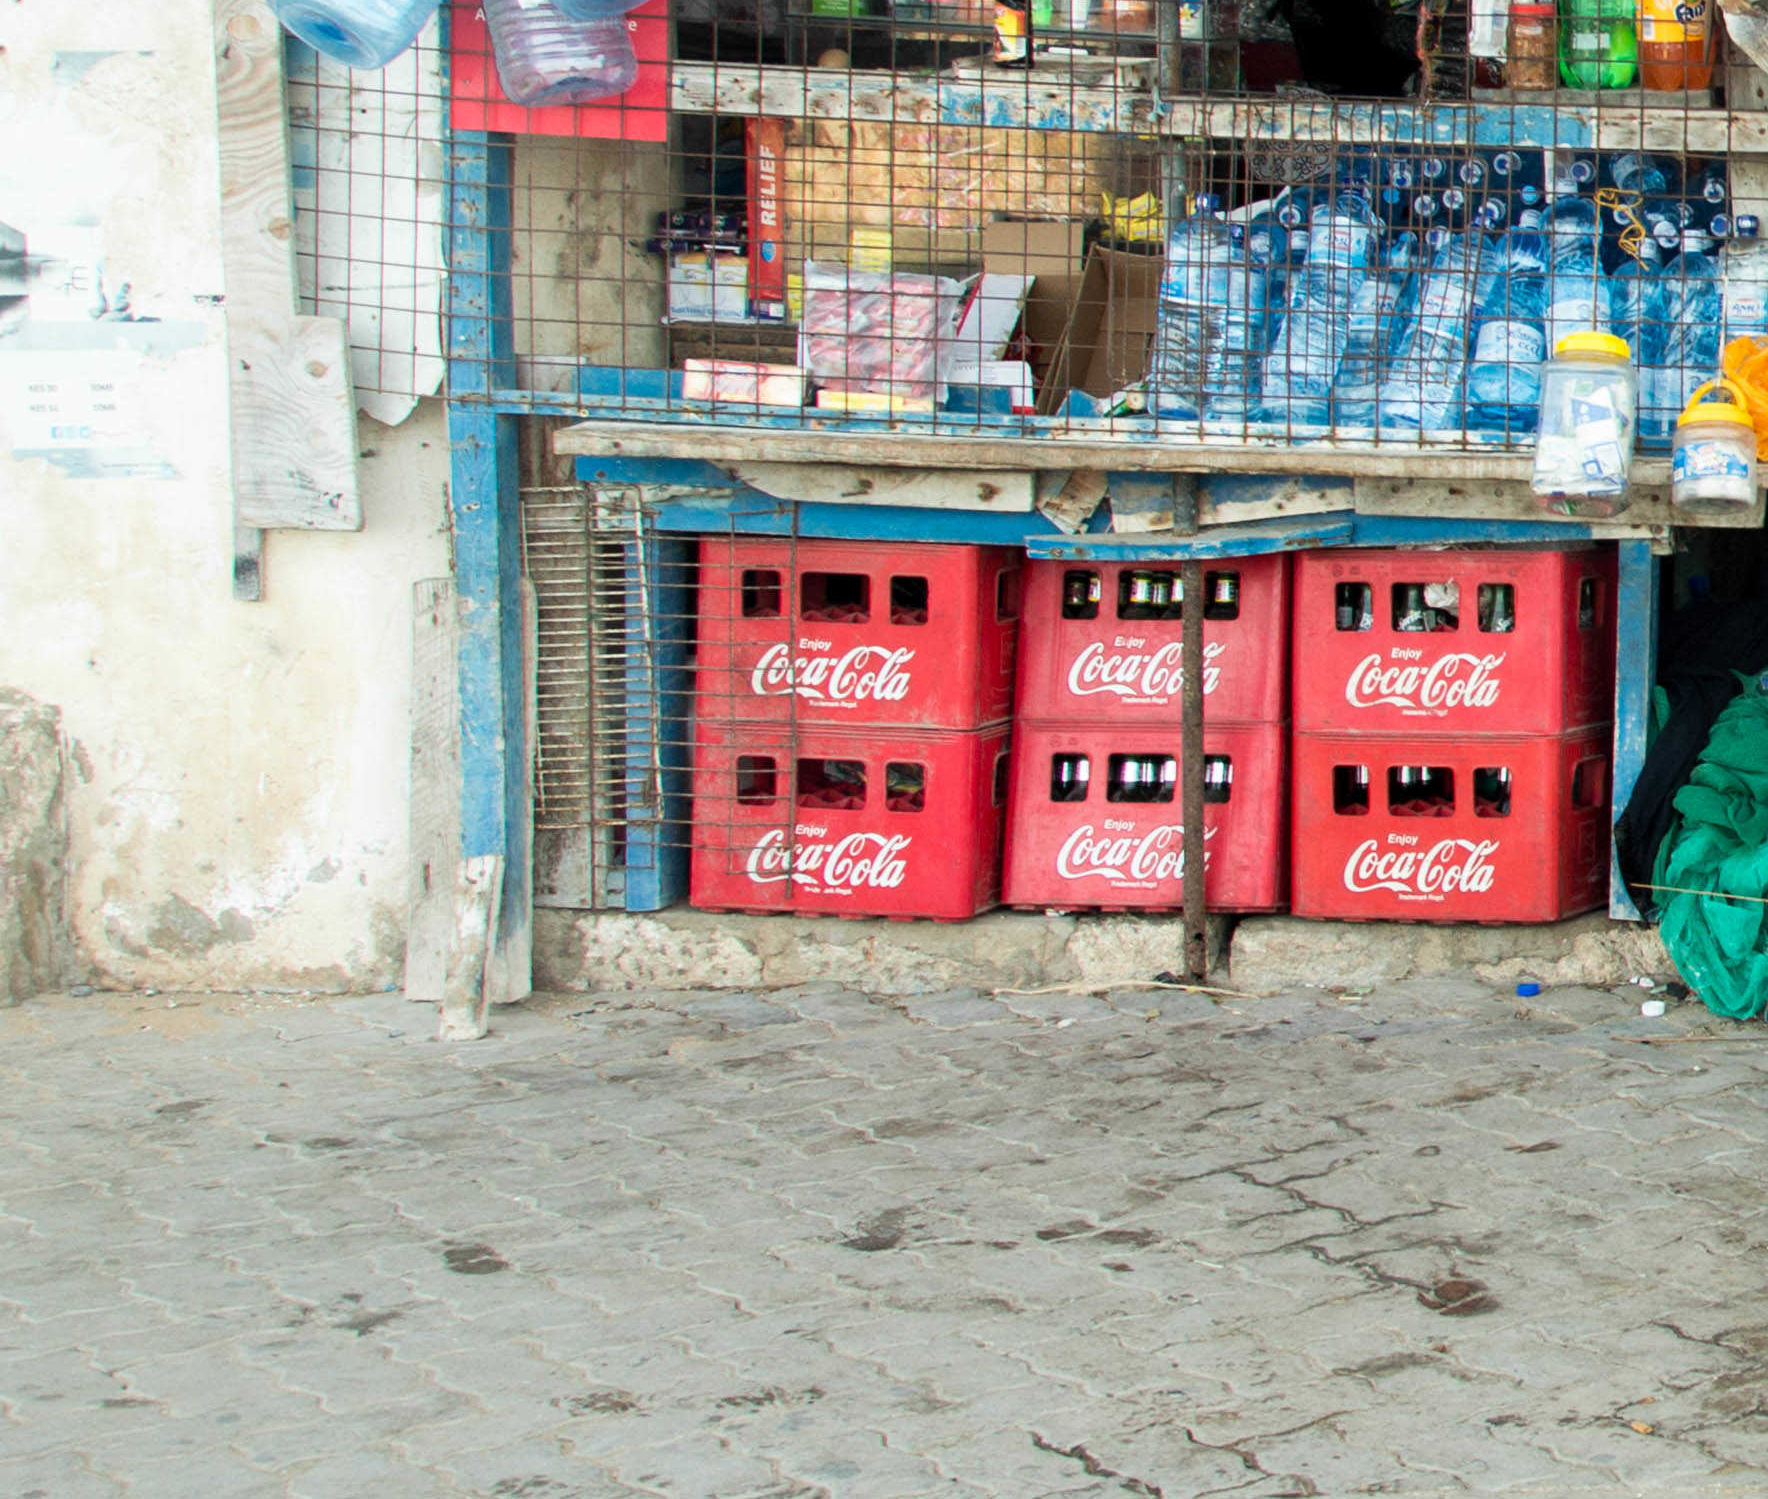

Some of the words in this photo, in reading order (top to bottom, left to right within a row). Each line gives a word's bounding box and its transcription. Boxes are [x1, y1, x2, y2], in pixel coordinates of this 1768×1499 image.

[760, 145, 777, 227] RELIEF
[752, 643, 916, 701] Coca-Cola
[799, 637, 832, 653] Enjoy
[1067, 641, 1226, 696] Coca-Coa
[1391, 647, 1423, 660] Enjoy
[1345, 651, 1507, 709] Coca-Cola
[795, 824, 827, 838] Enjoy
[1104, 818, 1136, 833] Enjoy
[1387, 833, 1419, 846] Enjoy
[747, 829, 913, 889] Coca-Cola
[1343, 838, 1500, 893] Coca-Cola
